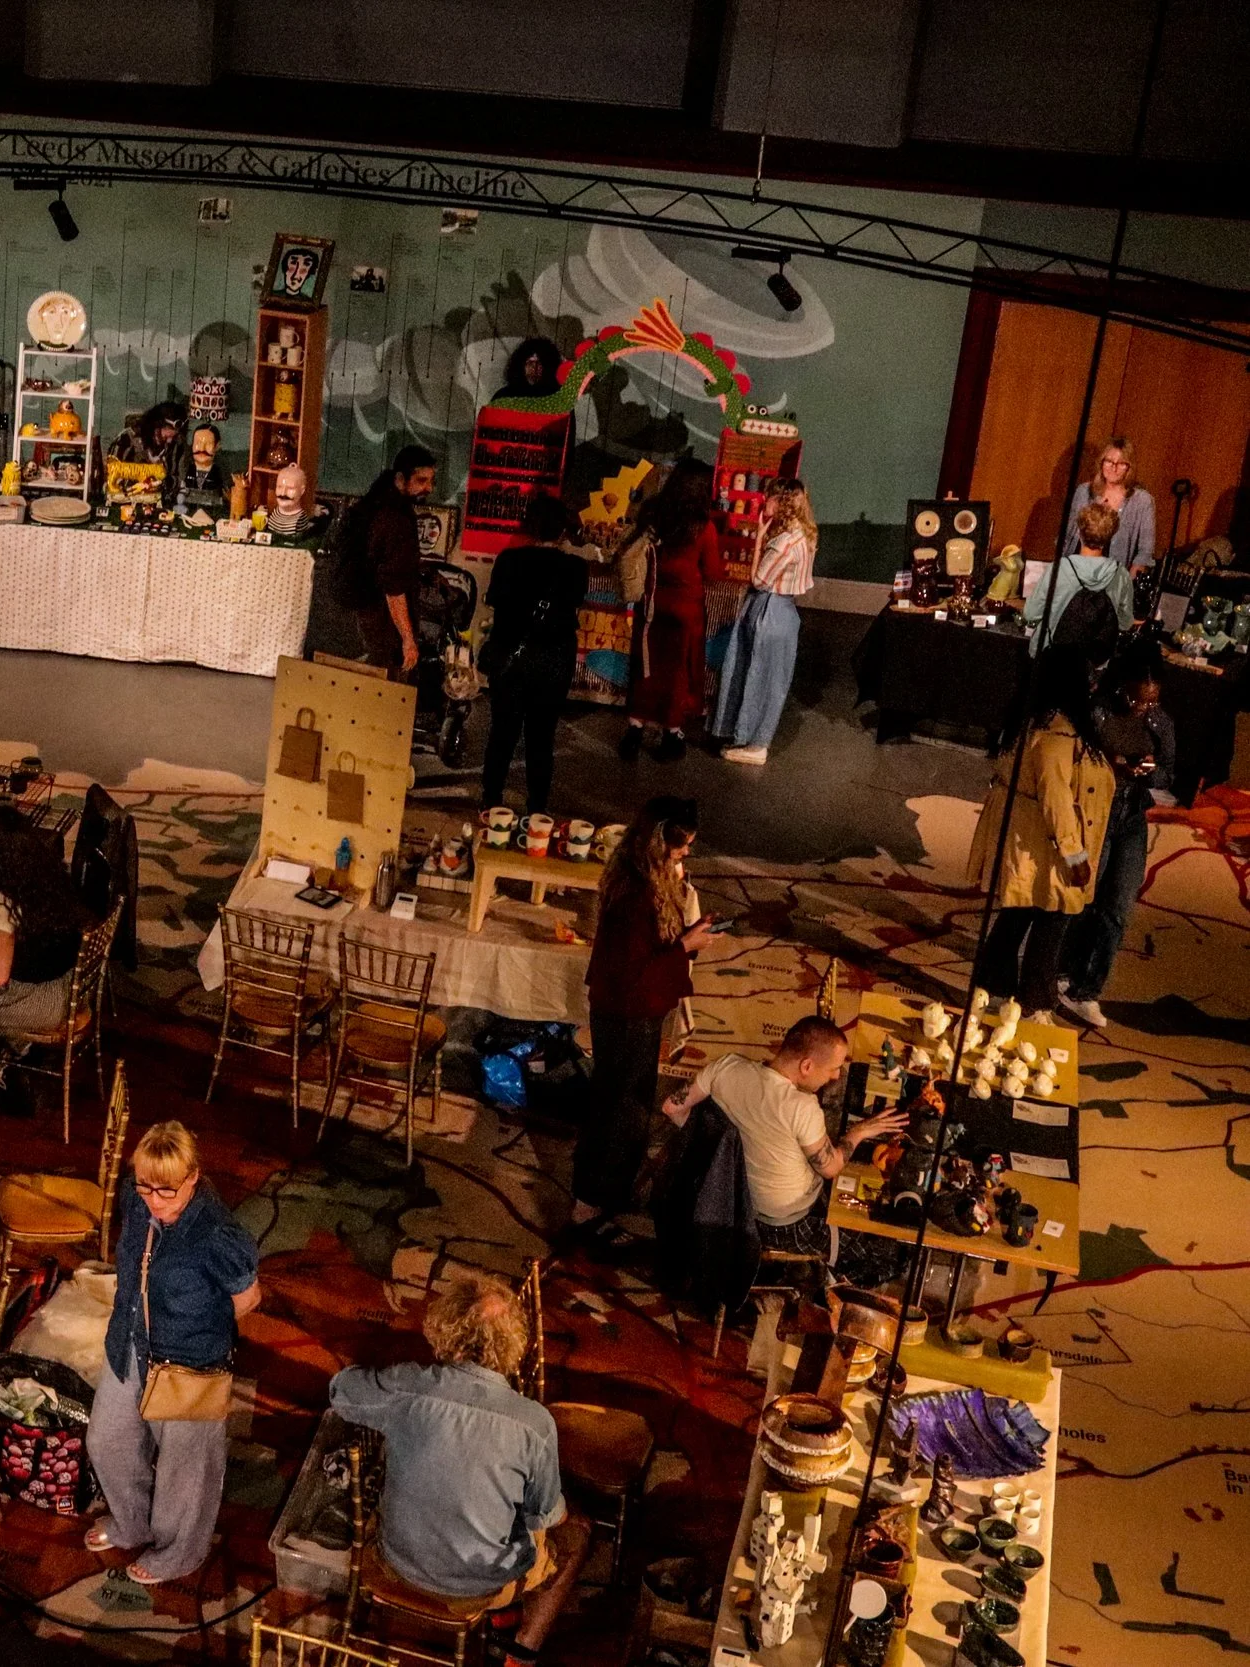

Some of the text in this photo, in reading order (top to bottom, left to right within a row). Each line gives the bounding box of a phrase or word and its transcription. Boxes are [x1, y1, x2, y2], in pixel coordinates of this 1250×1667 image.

[12, 135, 86, 162] Leeds
[98, 141, 228, 172] Museums
[269, 153, 391, 186] Galleries
[405, 164, 527, 199] Timeline
[1058, 1424, 1108, 1444] holes
